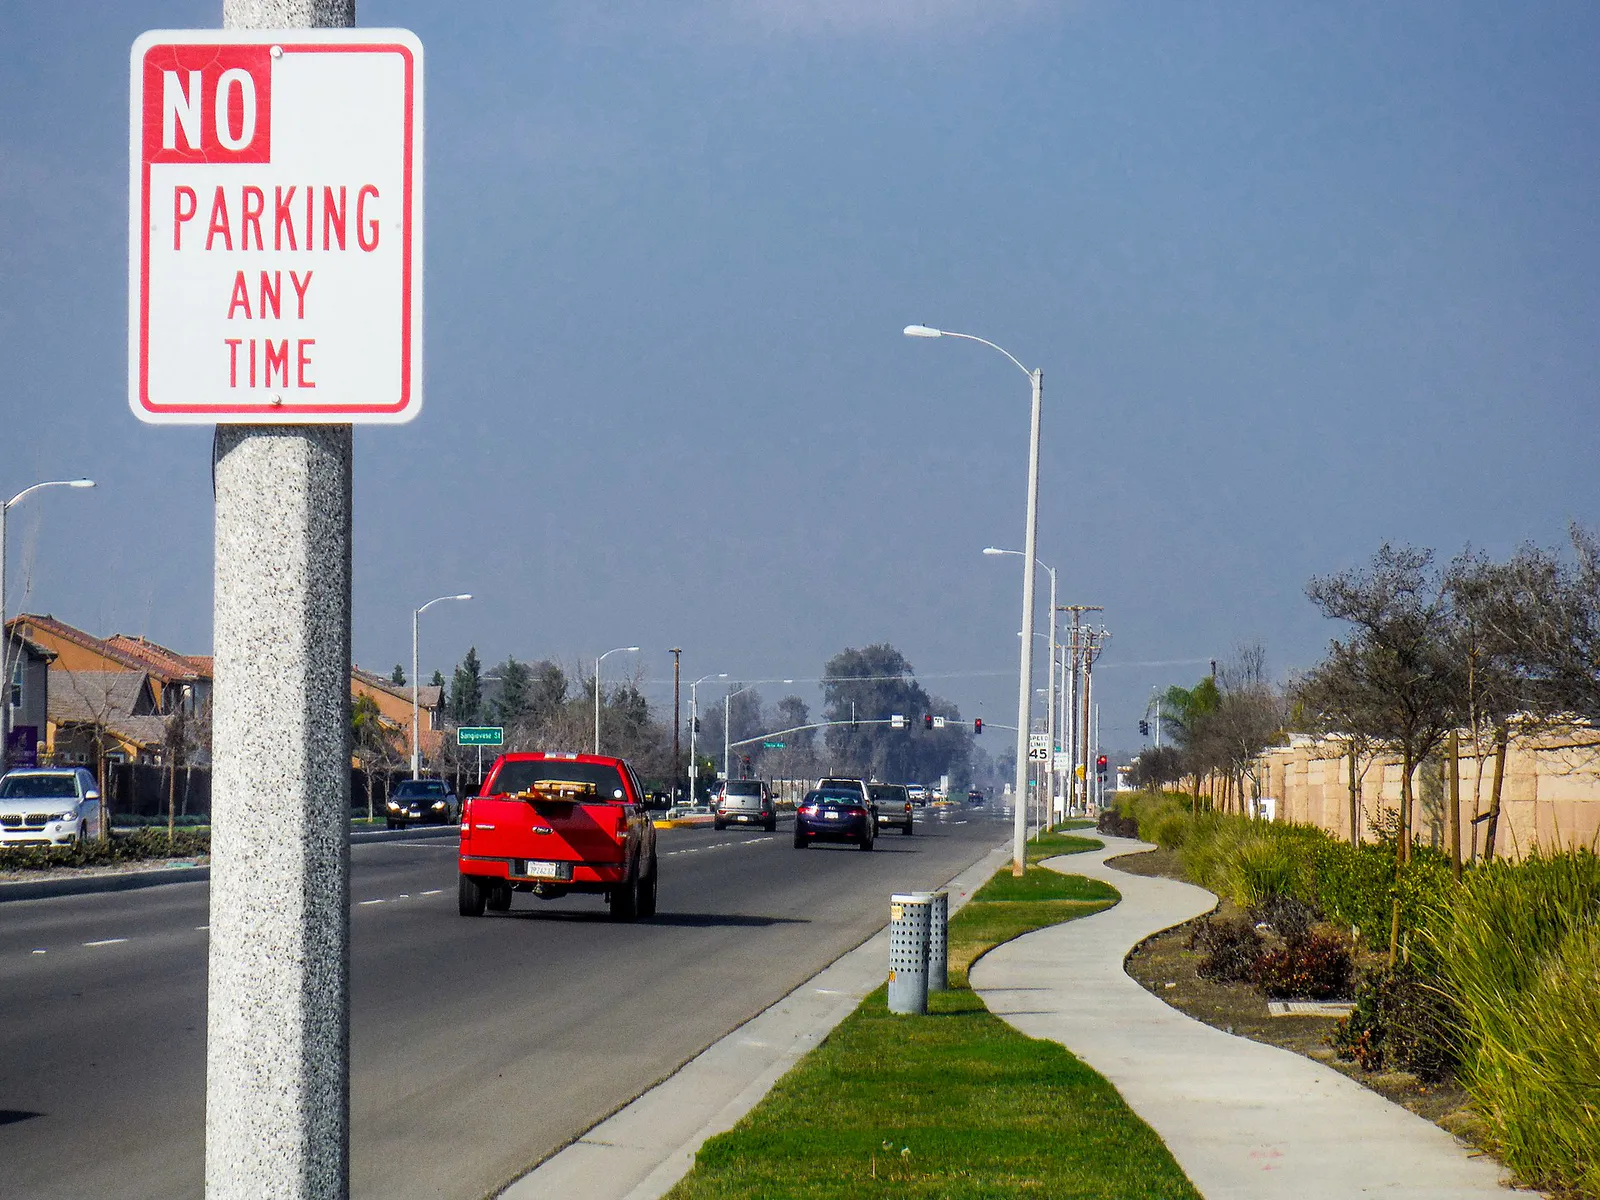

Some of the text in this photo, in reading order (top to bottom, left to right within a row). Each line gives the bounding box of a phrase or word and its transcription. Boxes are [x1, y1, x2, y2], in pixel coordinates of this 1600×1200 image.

[162, 69, 257, 151] NO
[173, 185, 380, 252] PARKING
[227, 271, 313, 320] ANY
[225, 338, 316, 389] TIME
[1029, 748, 1047, 759] 45
